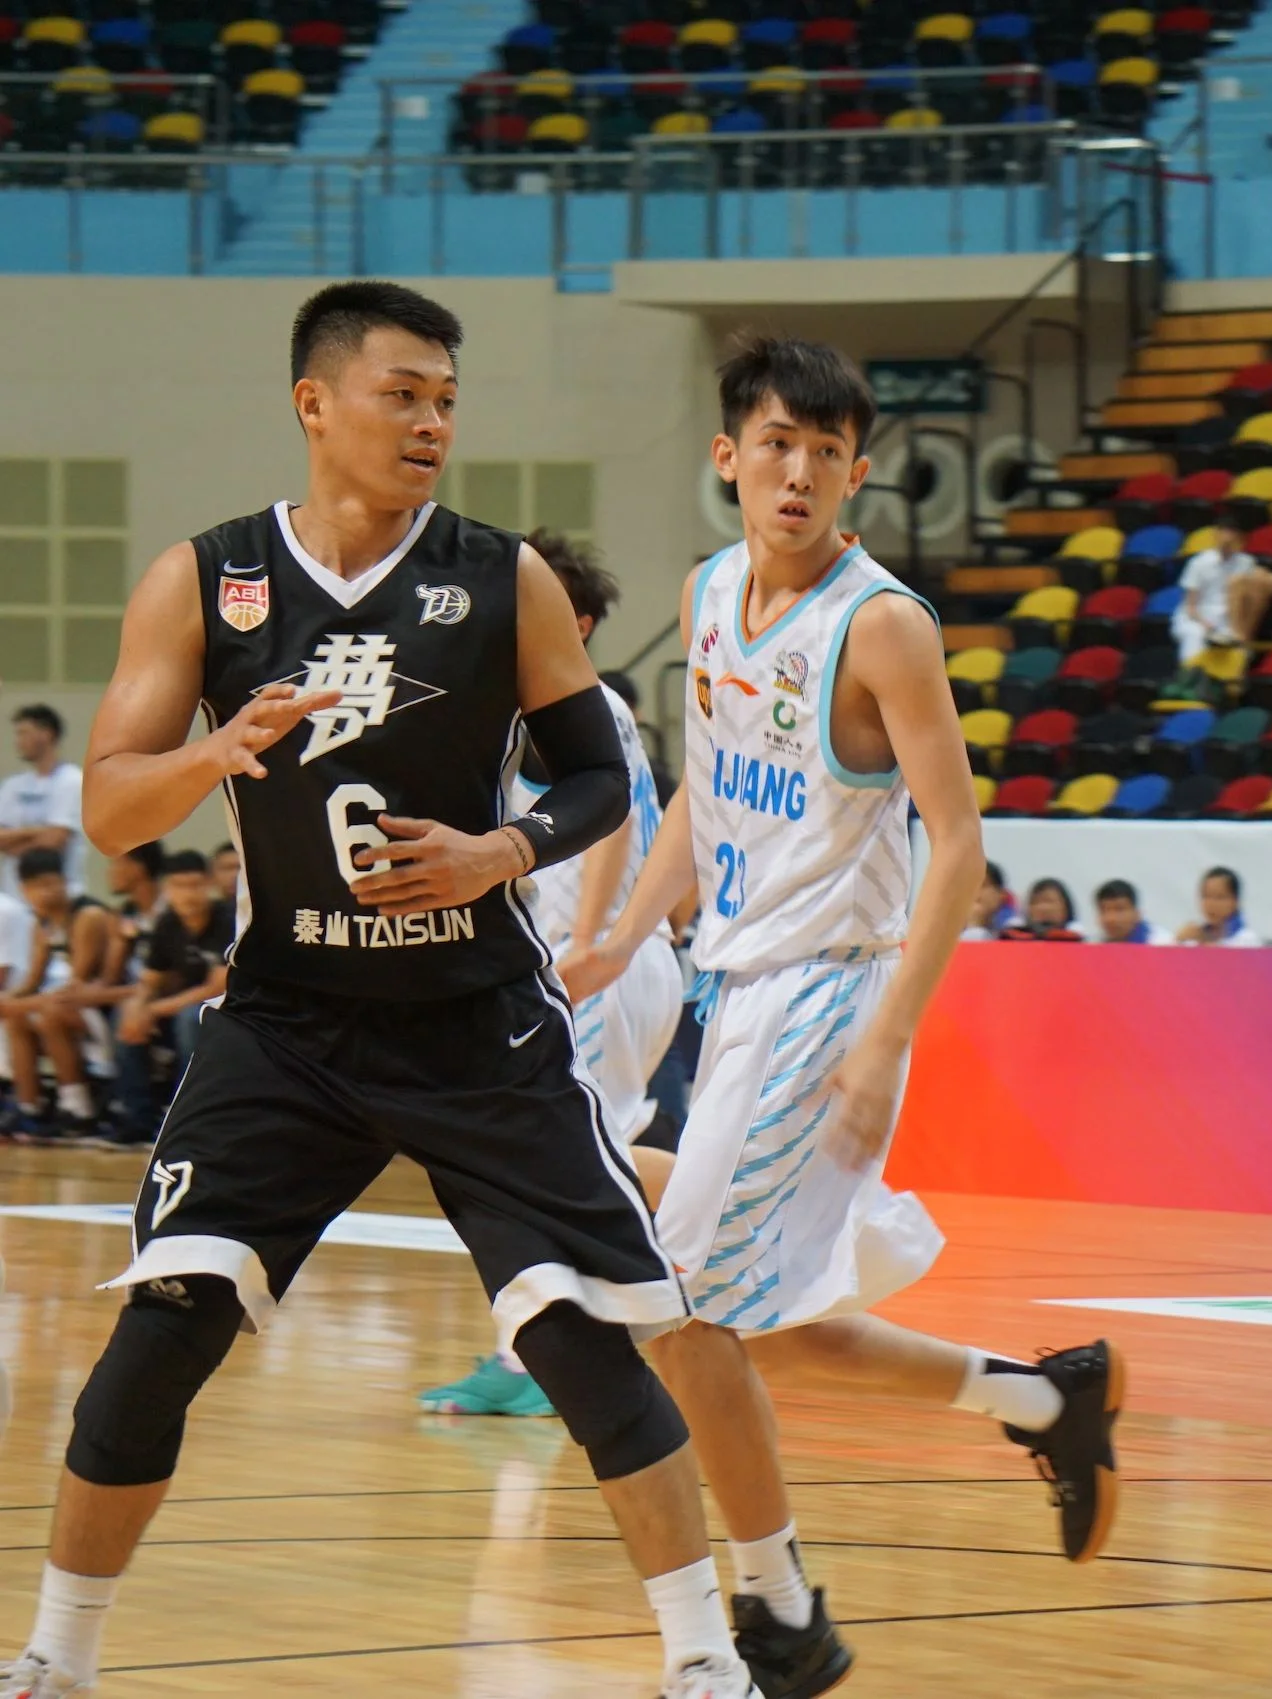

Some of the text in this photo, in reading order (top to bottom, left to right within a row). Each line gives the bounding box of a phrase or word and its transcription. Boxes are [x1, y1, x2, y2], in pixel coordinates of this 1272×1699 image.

[225, 586, 267, 601] ABL
[326, 783, 392, 887] 6
[292, 907, 476, 949] 泰山 TAISUN
